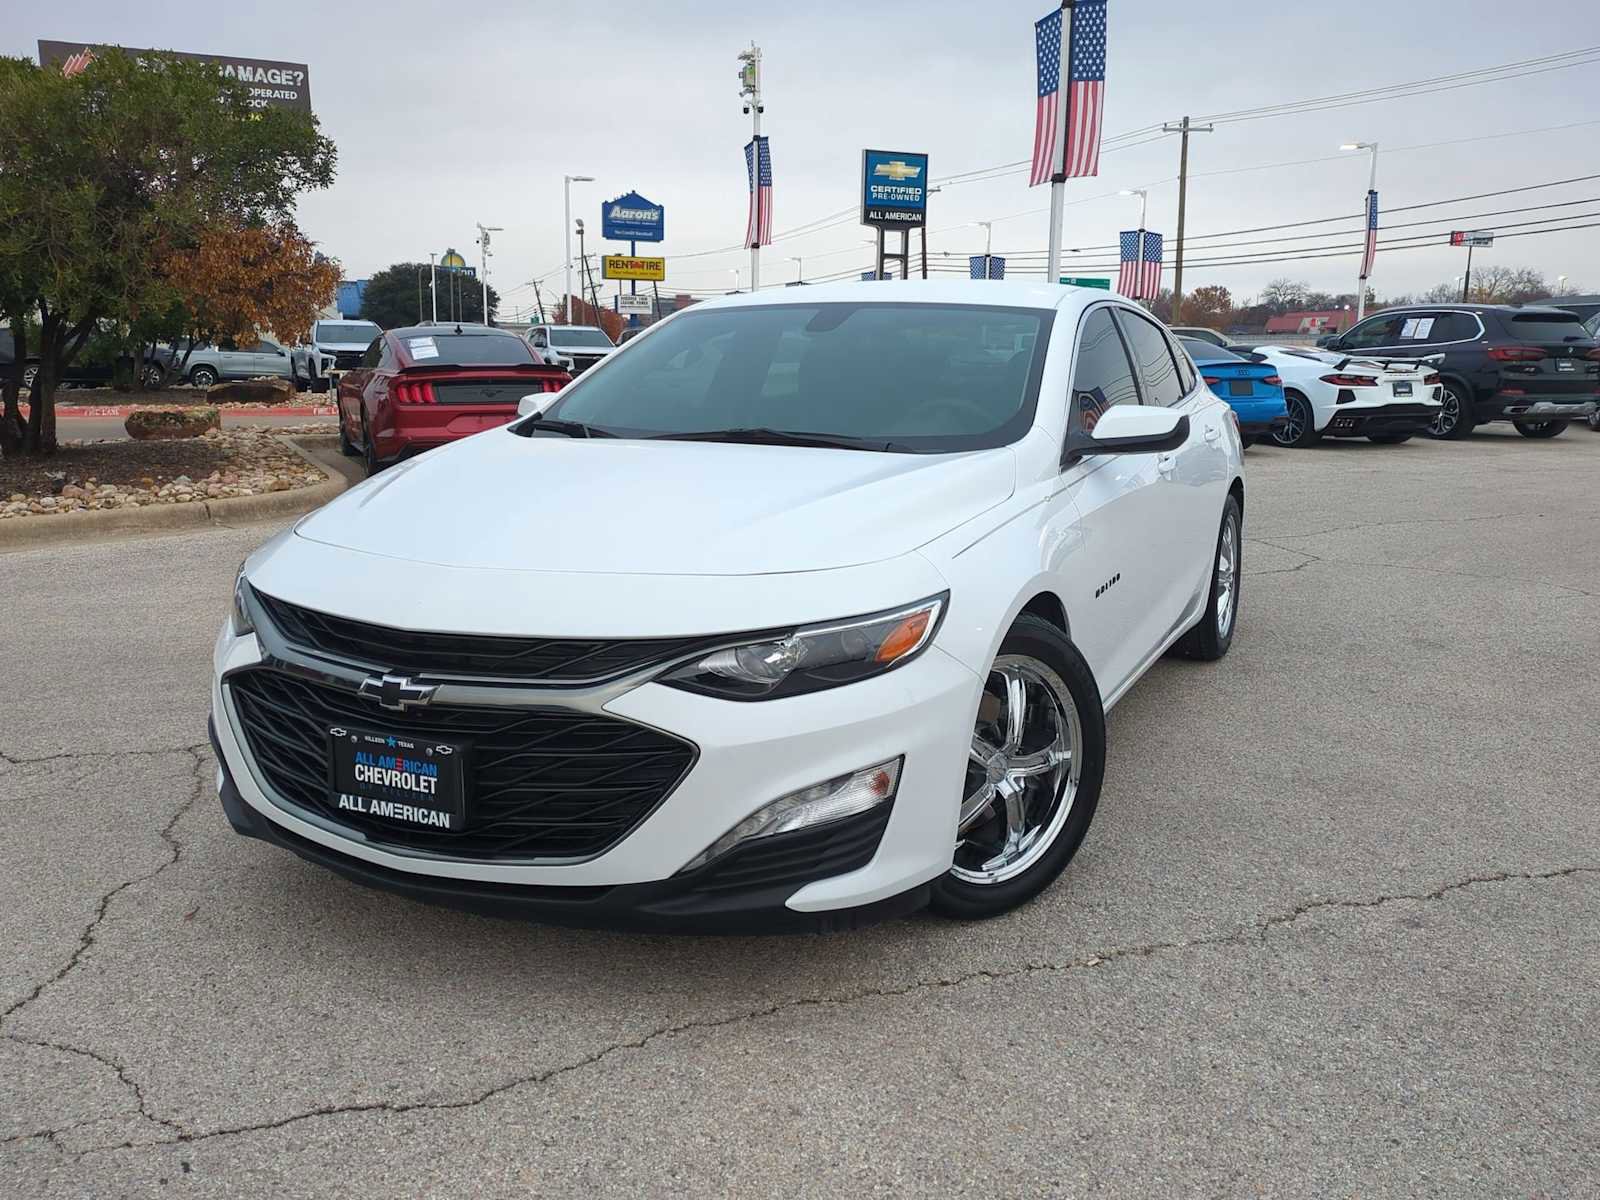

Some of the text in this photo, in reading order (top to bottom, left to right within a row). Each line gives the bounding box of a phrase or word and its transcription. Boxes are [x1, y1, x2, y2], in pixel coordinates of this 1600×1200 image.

[870, 185, 922, 195] CERTIFIED
[872, 192, 920, 202] PRE-OWNED
[610, 205, 659, 220] Aaron's
[869, 210, 922, 222] ALL AMERICAN
[608, 259, 662, 271] RENT TIRE
[364, 735, 415, 749] KILLEEN TEXAS
[355, 751, 438, 777] ALL AMERICAN
[354, 764, 438, 794] CHEVROLET
[338, 793, 450, 829] ALL AMERICAN
